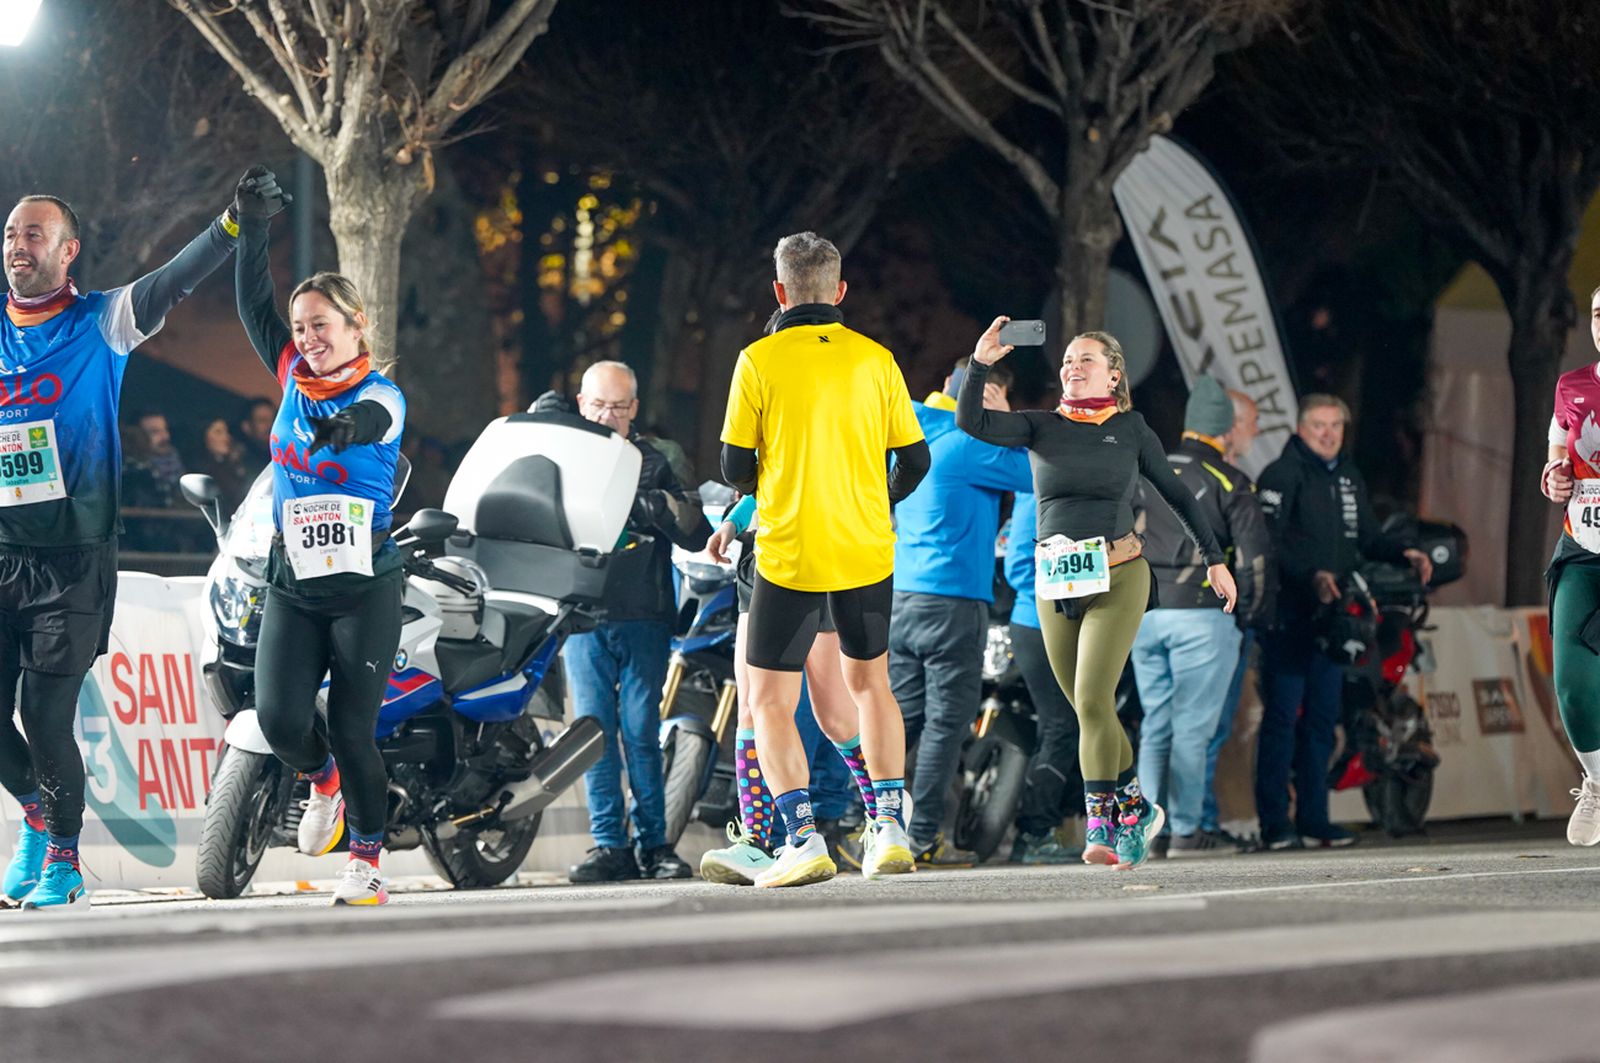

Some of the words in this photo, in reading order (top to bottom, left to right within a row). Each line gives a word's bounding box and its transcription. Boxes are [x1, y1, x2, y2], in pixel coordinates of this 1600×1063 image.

[1184, 194, 1292, 437] JAPEMASA
[0, 451, 44, 479] 599
[269, 432, 349, 486] GALO
[303, 503, 328, 513] NOCHE
[331, 502, 341, 511] DE
[313, 512, 341, 521] ANTON
[302, 522, 355, 549] 3981
[111, 652, 197, 725] SAN
[138, 738, 225, 810] ANT
